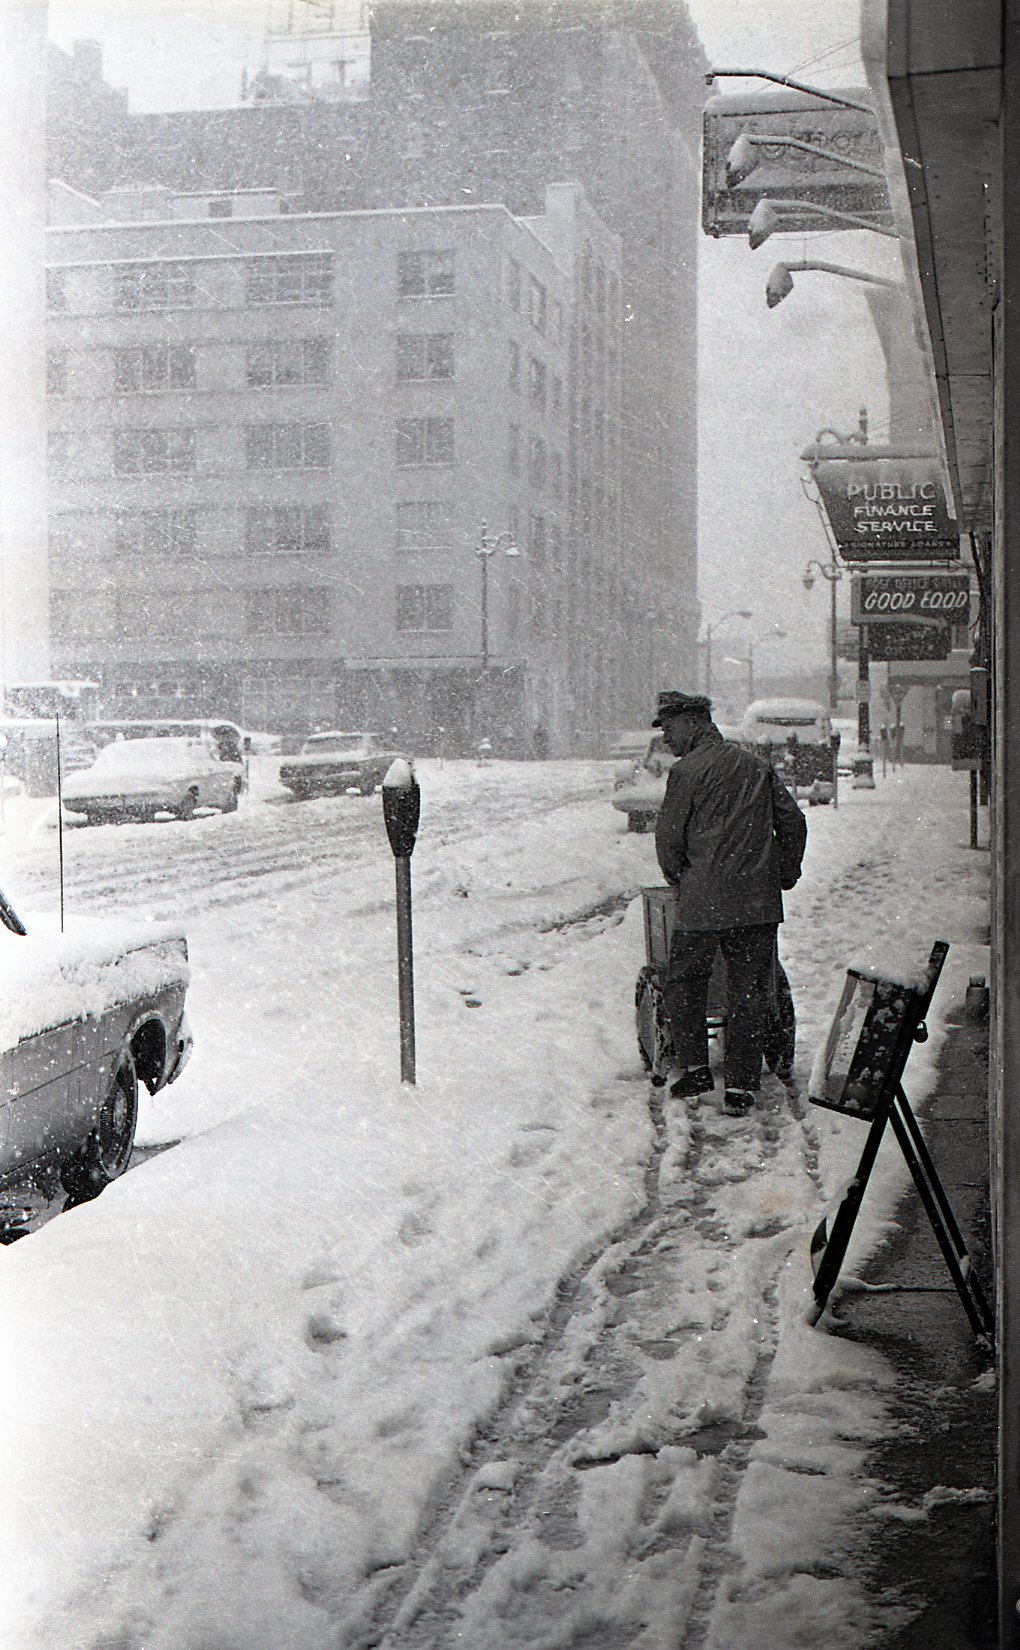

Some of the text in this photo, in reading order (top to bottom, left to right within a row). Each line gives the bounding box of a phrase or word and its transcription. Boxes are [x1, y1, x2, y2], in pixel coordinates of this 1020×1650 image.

[847, 482, 936, 500] PUBLIC
[853, 504, 937, 518] FINANCE
[853, 520, 939, 533] SERVICE
[864, 591, 968, 610] GOOD FOOD
